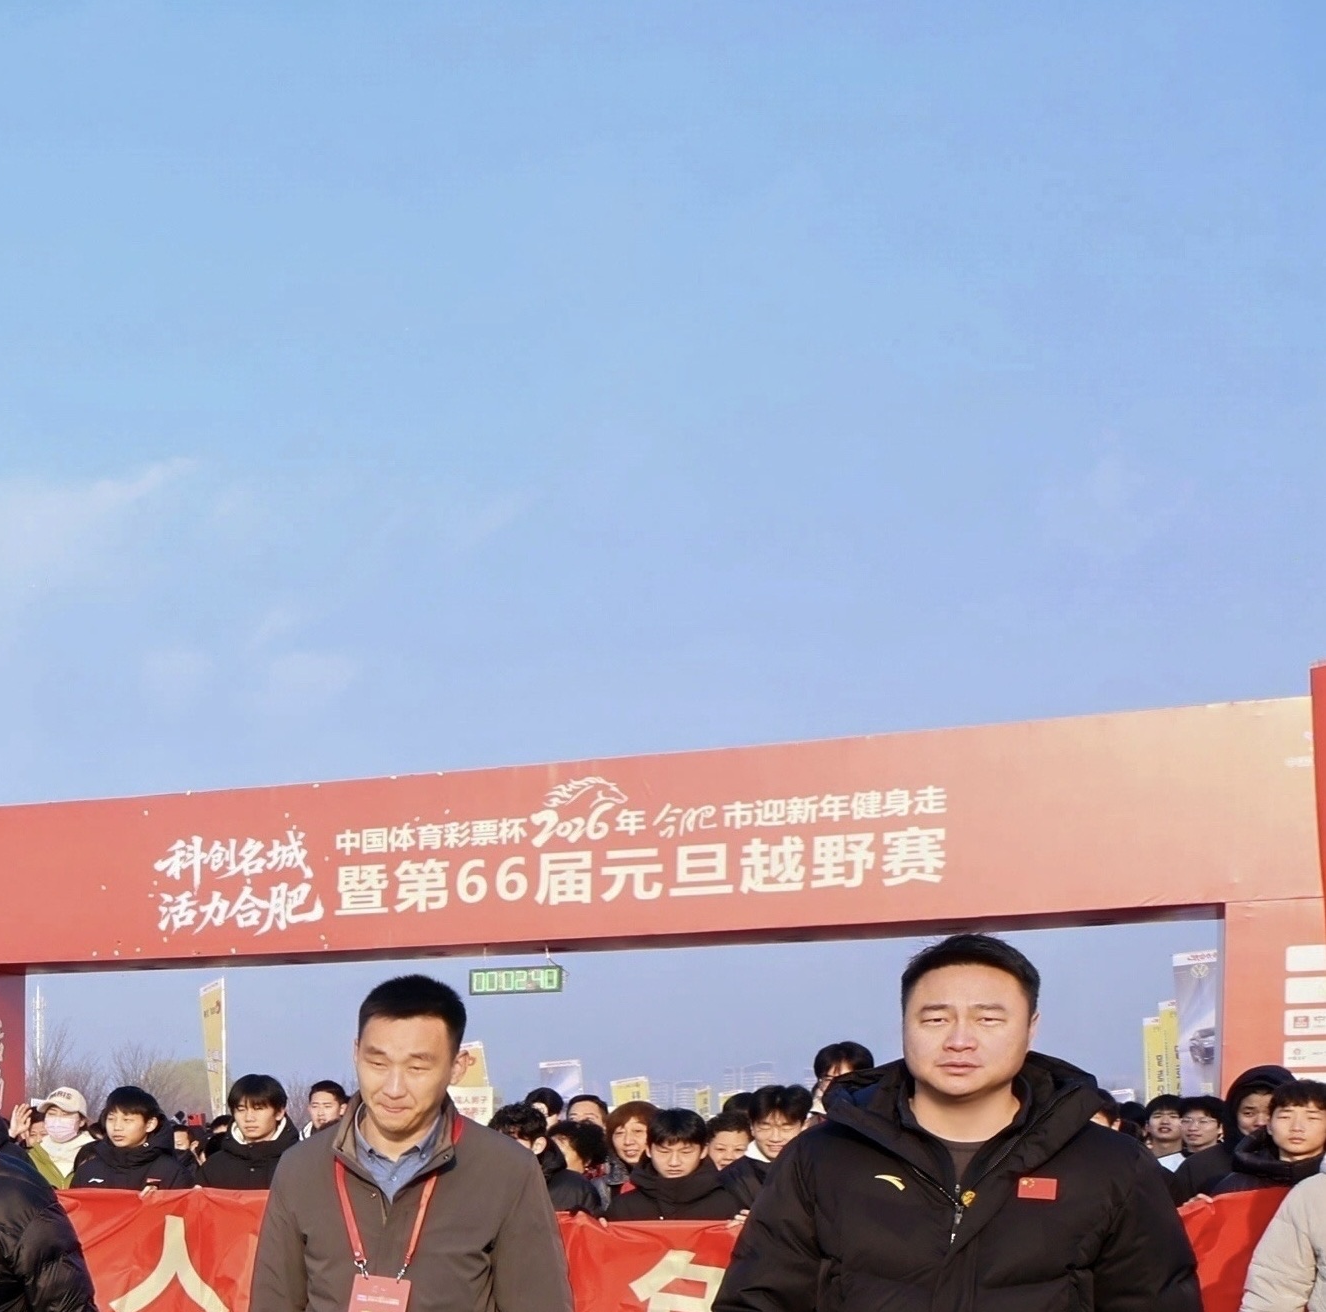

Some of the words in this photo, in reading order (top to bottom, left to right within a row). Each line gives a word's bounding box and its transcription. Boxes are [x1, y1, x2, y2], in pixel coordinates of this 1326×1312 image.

[154, 830, 314, 895] 科创名城
[334, 826, 947, 916] 暨第66届元旦越野赛
[158, 882, 324, 936] 活力合肥
